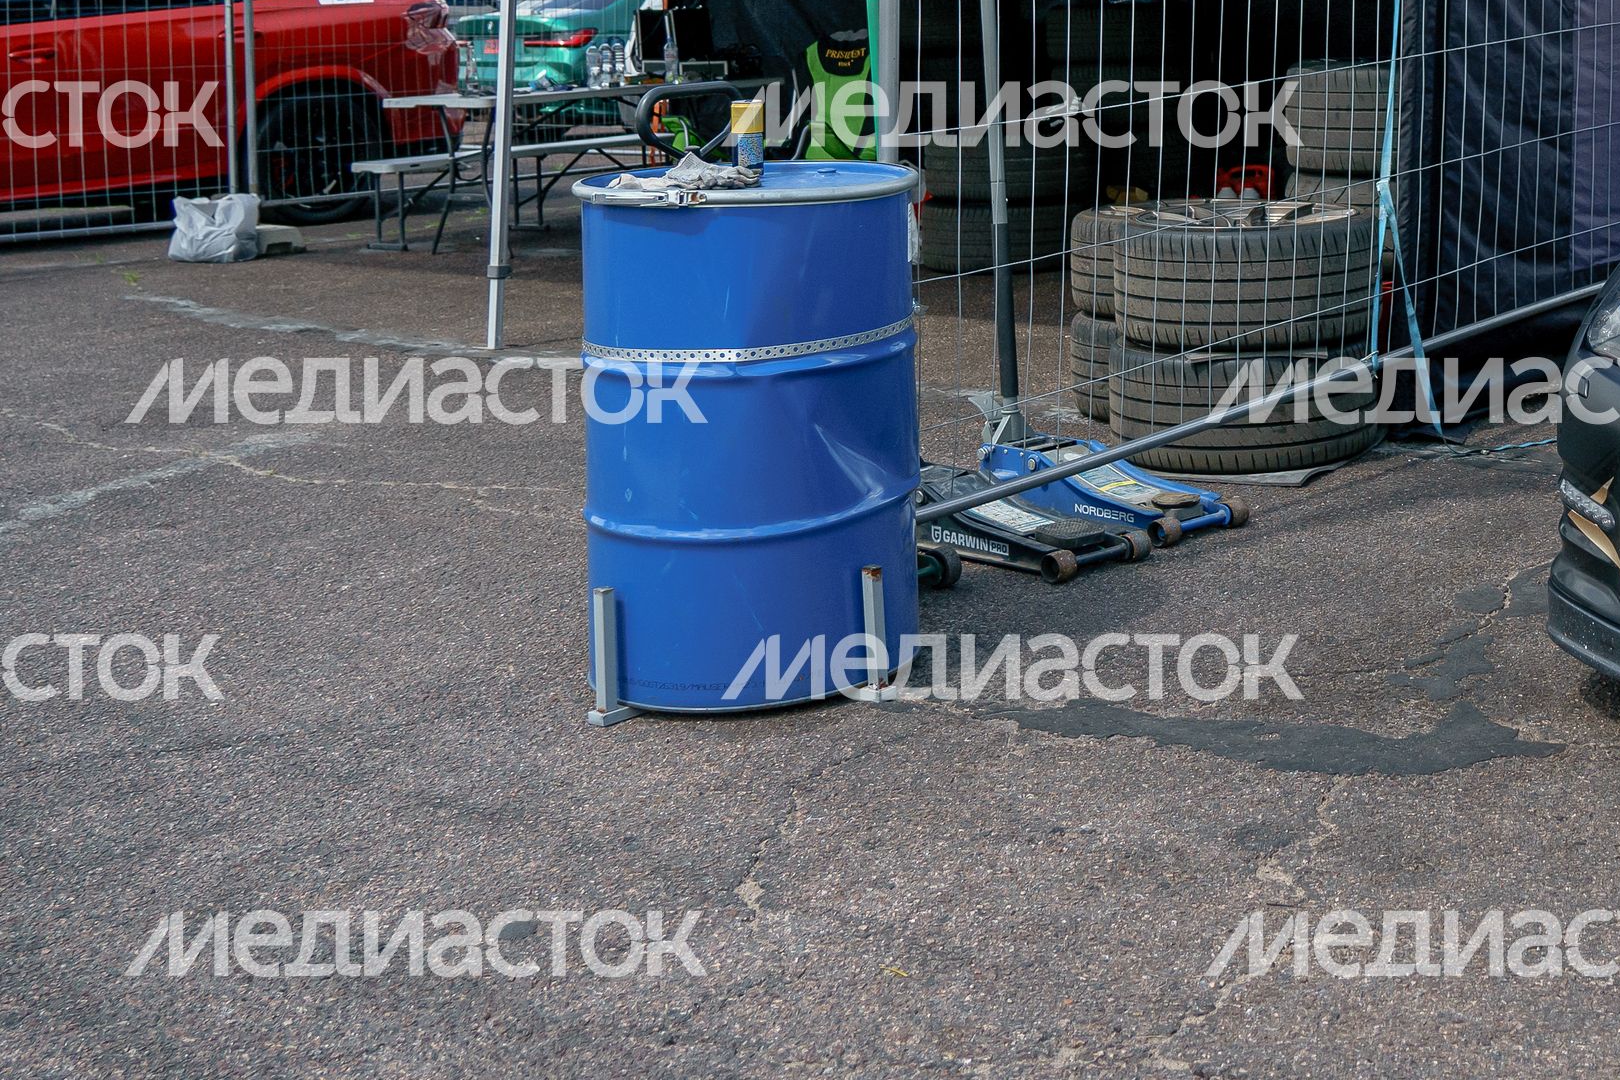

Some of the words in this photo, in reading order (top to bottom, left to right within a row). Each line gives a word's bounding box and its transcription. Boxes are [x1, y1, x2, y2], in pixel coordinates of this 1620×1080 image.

[1074, 503, 1135, 523] NORDBERG
[942, 530, 988, 552] GARWIN
[990, 542, 1008, 554] PRO
